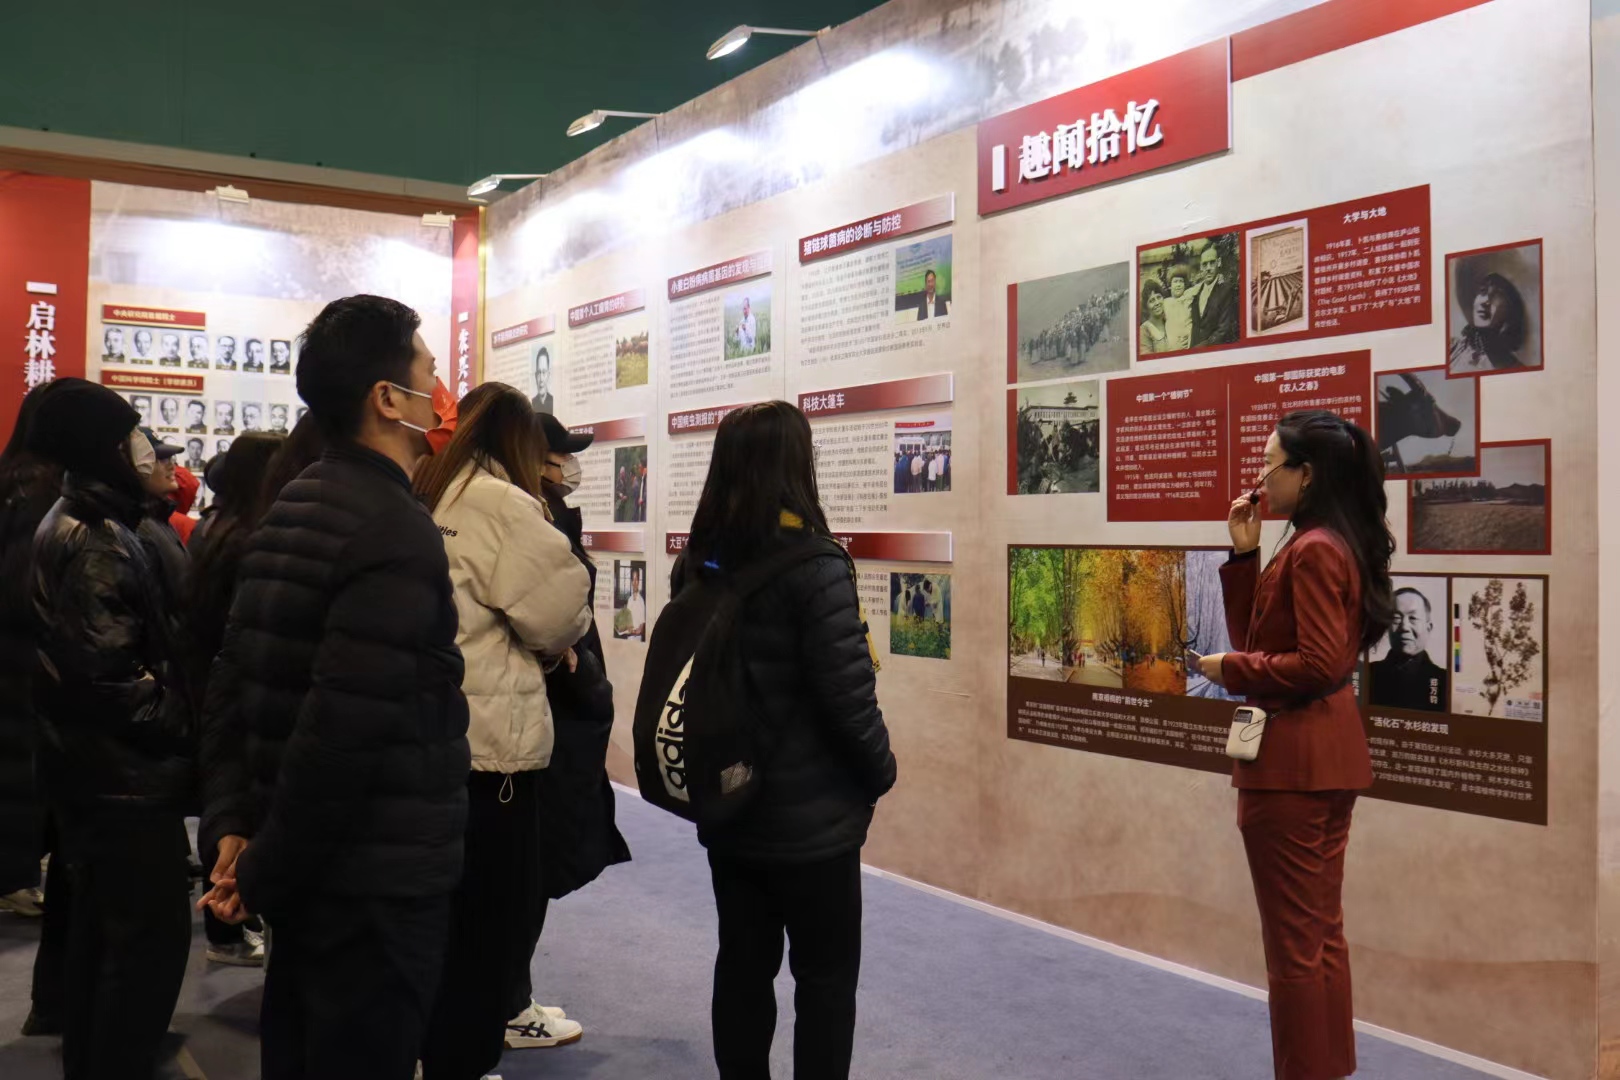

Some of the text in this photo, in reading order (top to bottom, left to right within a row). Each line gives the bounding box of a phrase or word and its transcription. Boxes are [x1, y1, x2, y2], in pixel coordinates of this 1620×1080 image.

[1018, 98, 1163, 183] 趣闻拾忆
[1342, 206, 1388, 224] 大学与大地
[803, 213, 902, 256] 猪链球菌病的诊断与防控
[24, 301, 57, 398] 启林耕
[1254, 365, 1346, 383] 中国第一部国际获奖的电影
[1279, 381, 1319, 394] 《农人之春》
[803, 392, 846, 413] 科技大篷车
[1369, 716, 1449, 735] “活化石”水杉的发现
